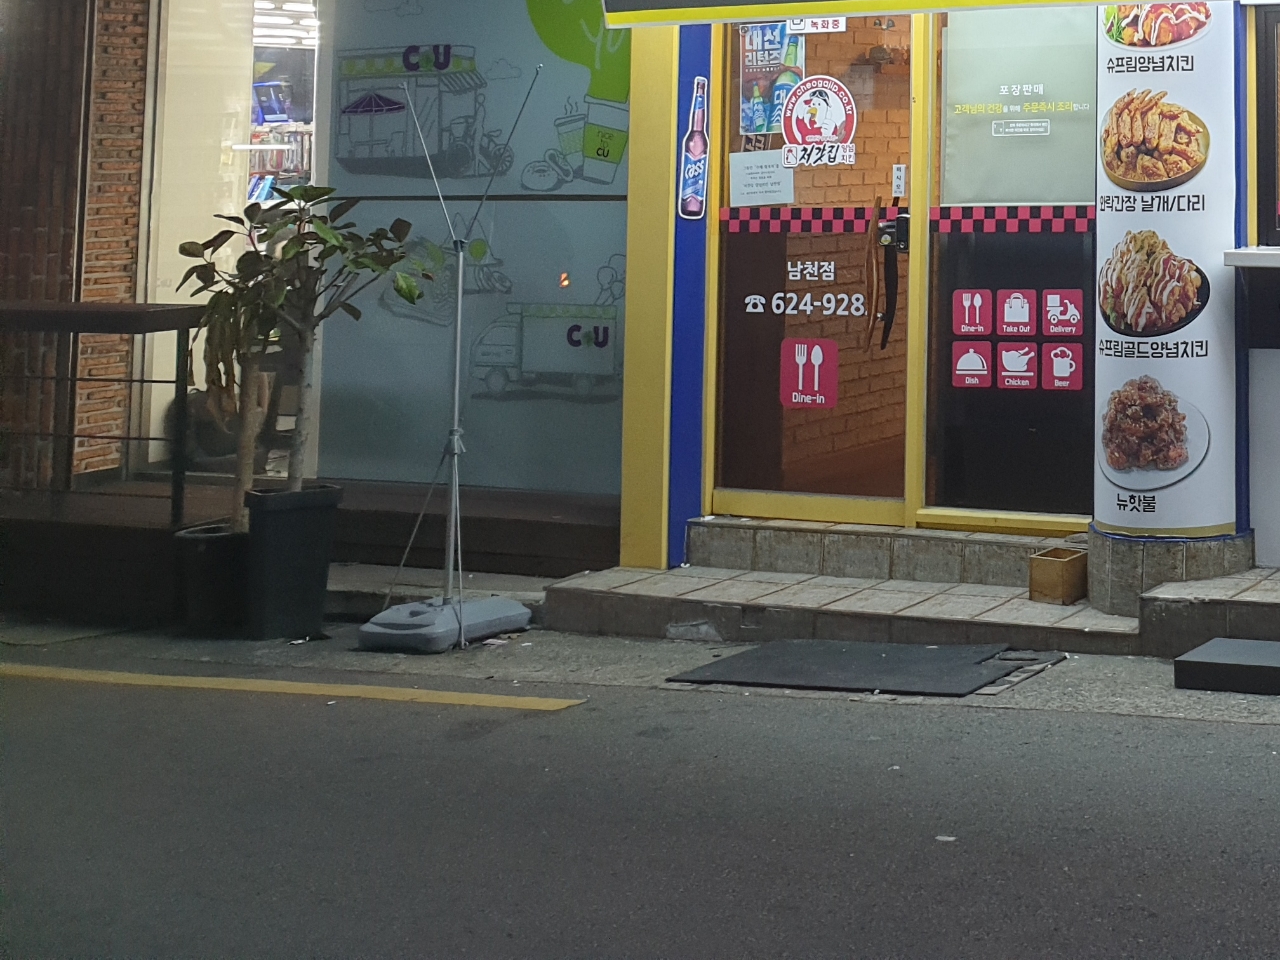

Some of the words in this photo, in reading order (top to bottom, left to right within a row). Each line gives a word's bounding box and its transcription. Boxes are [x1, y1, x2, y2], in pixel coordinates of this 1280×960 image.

[811, 19, 840, 30] 녹화중
[745, 29, 782, 50] 대선
[745, 51, 780, 66] 리턴즈
[1107, 55, 1194, 73] 슈프림양념치킨
[999, 84, 1044, 95] 포장판매
[785, 79, 852, 117] www.cheogajip.co.kr
[954, 103, 985, 114] 고객님의
[597, 147, 609, 158] CU
[799, 143, 840, 164] 처갓집
[1141, 194, 1205, 212] 날개/다리
[787, 261, 835, 280] 남천점
[771, 292, 867, 316] 624-928
[1019, 325, 1030, 333] Out
[1050, 325, 1076, 334] Delivery
[1099, 339, 1209, 358] 슈프림골드양념치킨
[1005, 378, 1029, 386] Chicken
[1054, 379, 1069, 387] Beer
[792, 392, 824, 404] Dine-in
[1116, 493, 1156, 512] 뉴핫불
